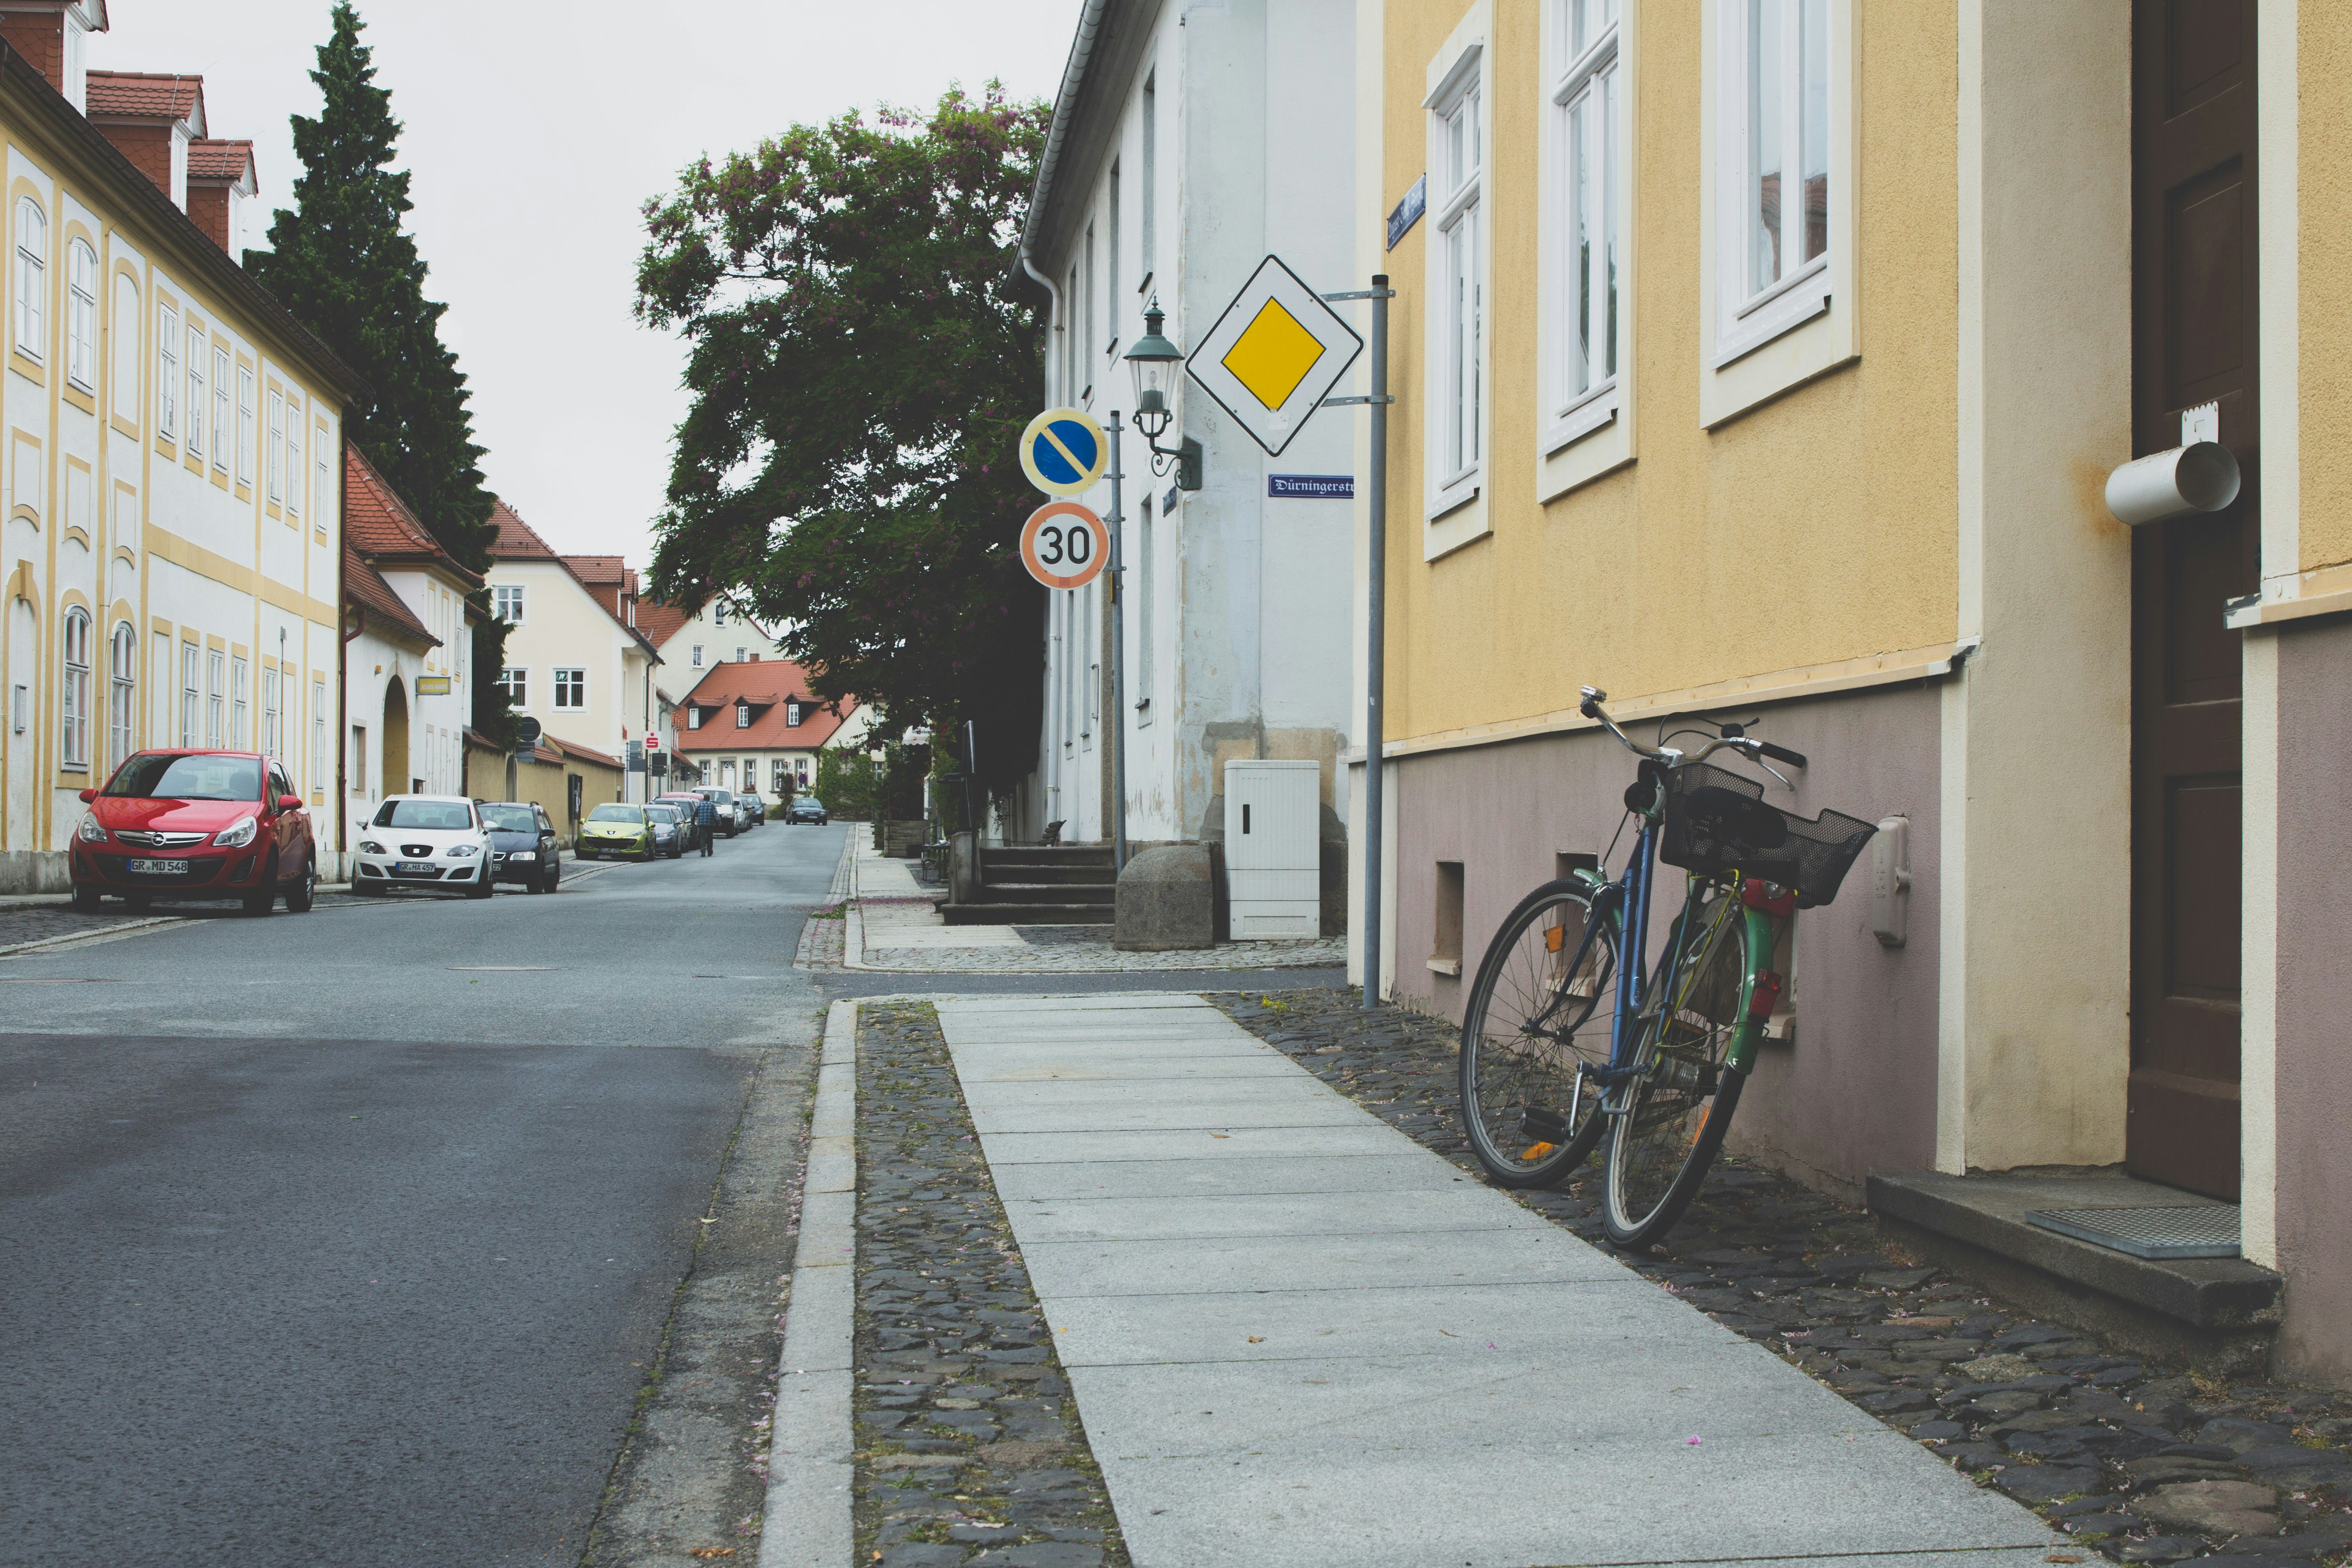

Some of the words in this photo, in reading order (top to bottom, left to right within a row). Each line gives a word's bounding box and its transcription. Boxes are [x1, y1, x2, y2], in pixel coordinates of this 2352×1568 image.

[1041, 526, 1090, 564] 30
[132, 860, 144, 870] GR
[152, 861, 165, 871] MD
[168, 862, 186, 871] 548
